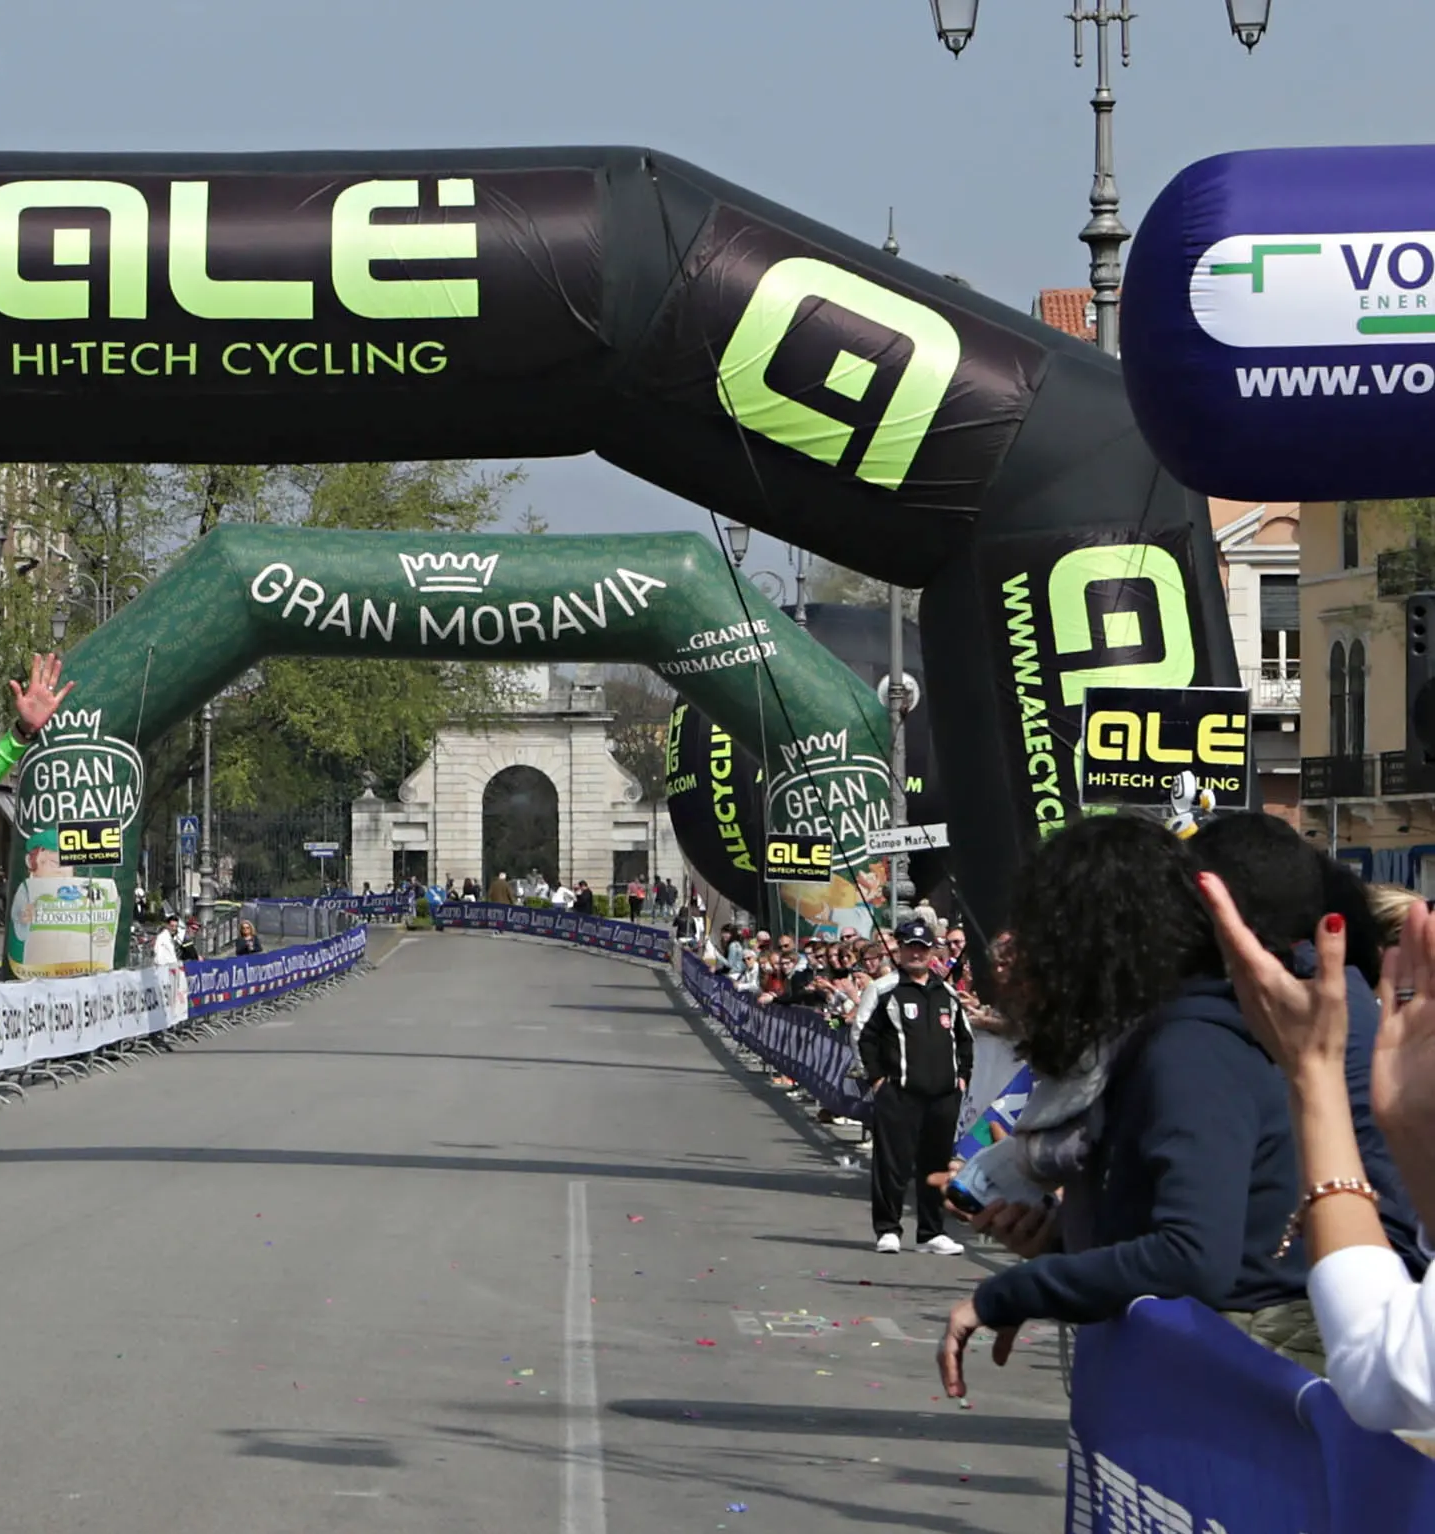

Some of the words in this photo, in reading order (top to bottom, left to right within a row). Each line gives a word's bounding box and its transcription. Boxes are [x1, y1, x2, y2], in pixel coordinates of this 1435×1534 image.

[1340, 242, 1435, 290] VO
[1360, 294, 1427, 310] ENER
[12, 342, 197, 376] HI-TECH
[221, 341, 448, 375] CYCLING
[251, 562, 397, 642] GRAN
[419, 566, 667, 646] MORAVIA
[658, 641, 777, 676] FORMAGGIO!
[34, 755, 114, 792] GRAN
[1088, 772, 1155, 788] HI-TECH
[1160, 775, 1241, 792] CLING
[19, 784, 138, 825] MORAVIA
[785, 773, 869, 819] GRAN
[89, 852, 119, 860] CYCLING
[869, 838, 902, 850] Campo
